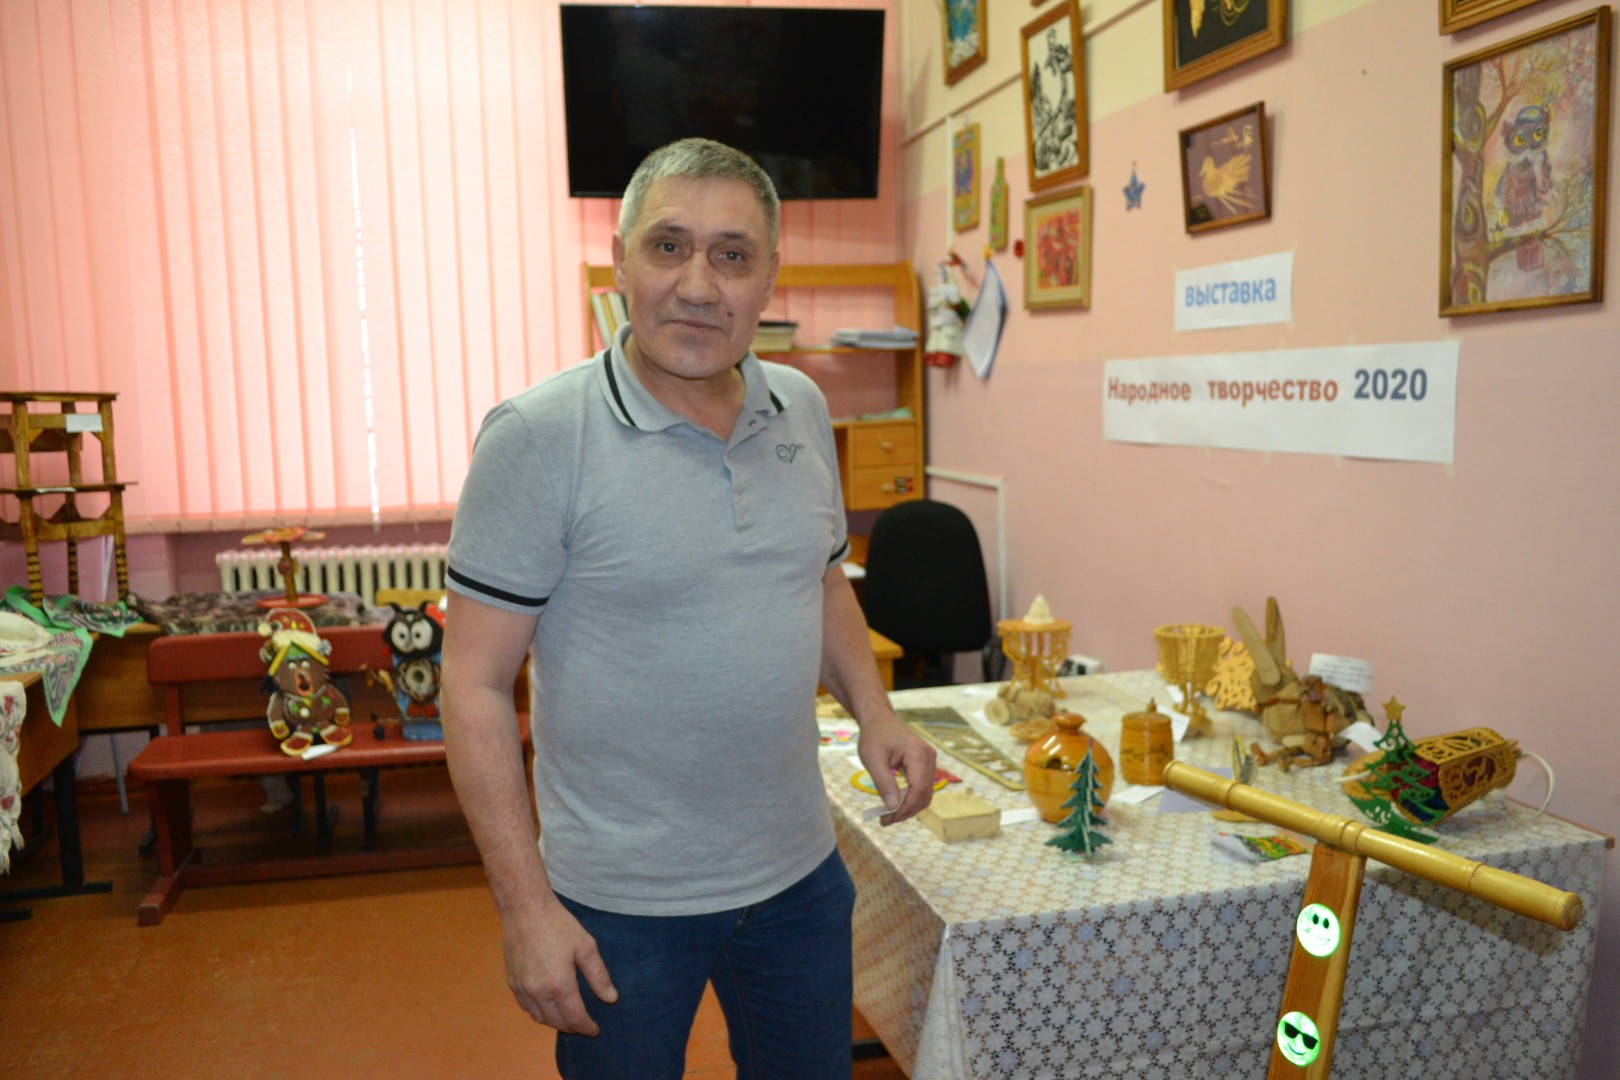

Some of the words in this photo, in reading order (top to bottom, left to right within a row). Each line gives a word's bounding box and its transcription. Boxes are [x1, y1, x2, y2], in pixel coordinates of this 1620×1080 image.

[1185, 277, 1277, 307] выставка
[1107, 376, 1192, 407] Народное
[1207, 379, 1339, 408] творчество
[1354, 368, 1428, 401] 2020
